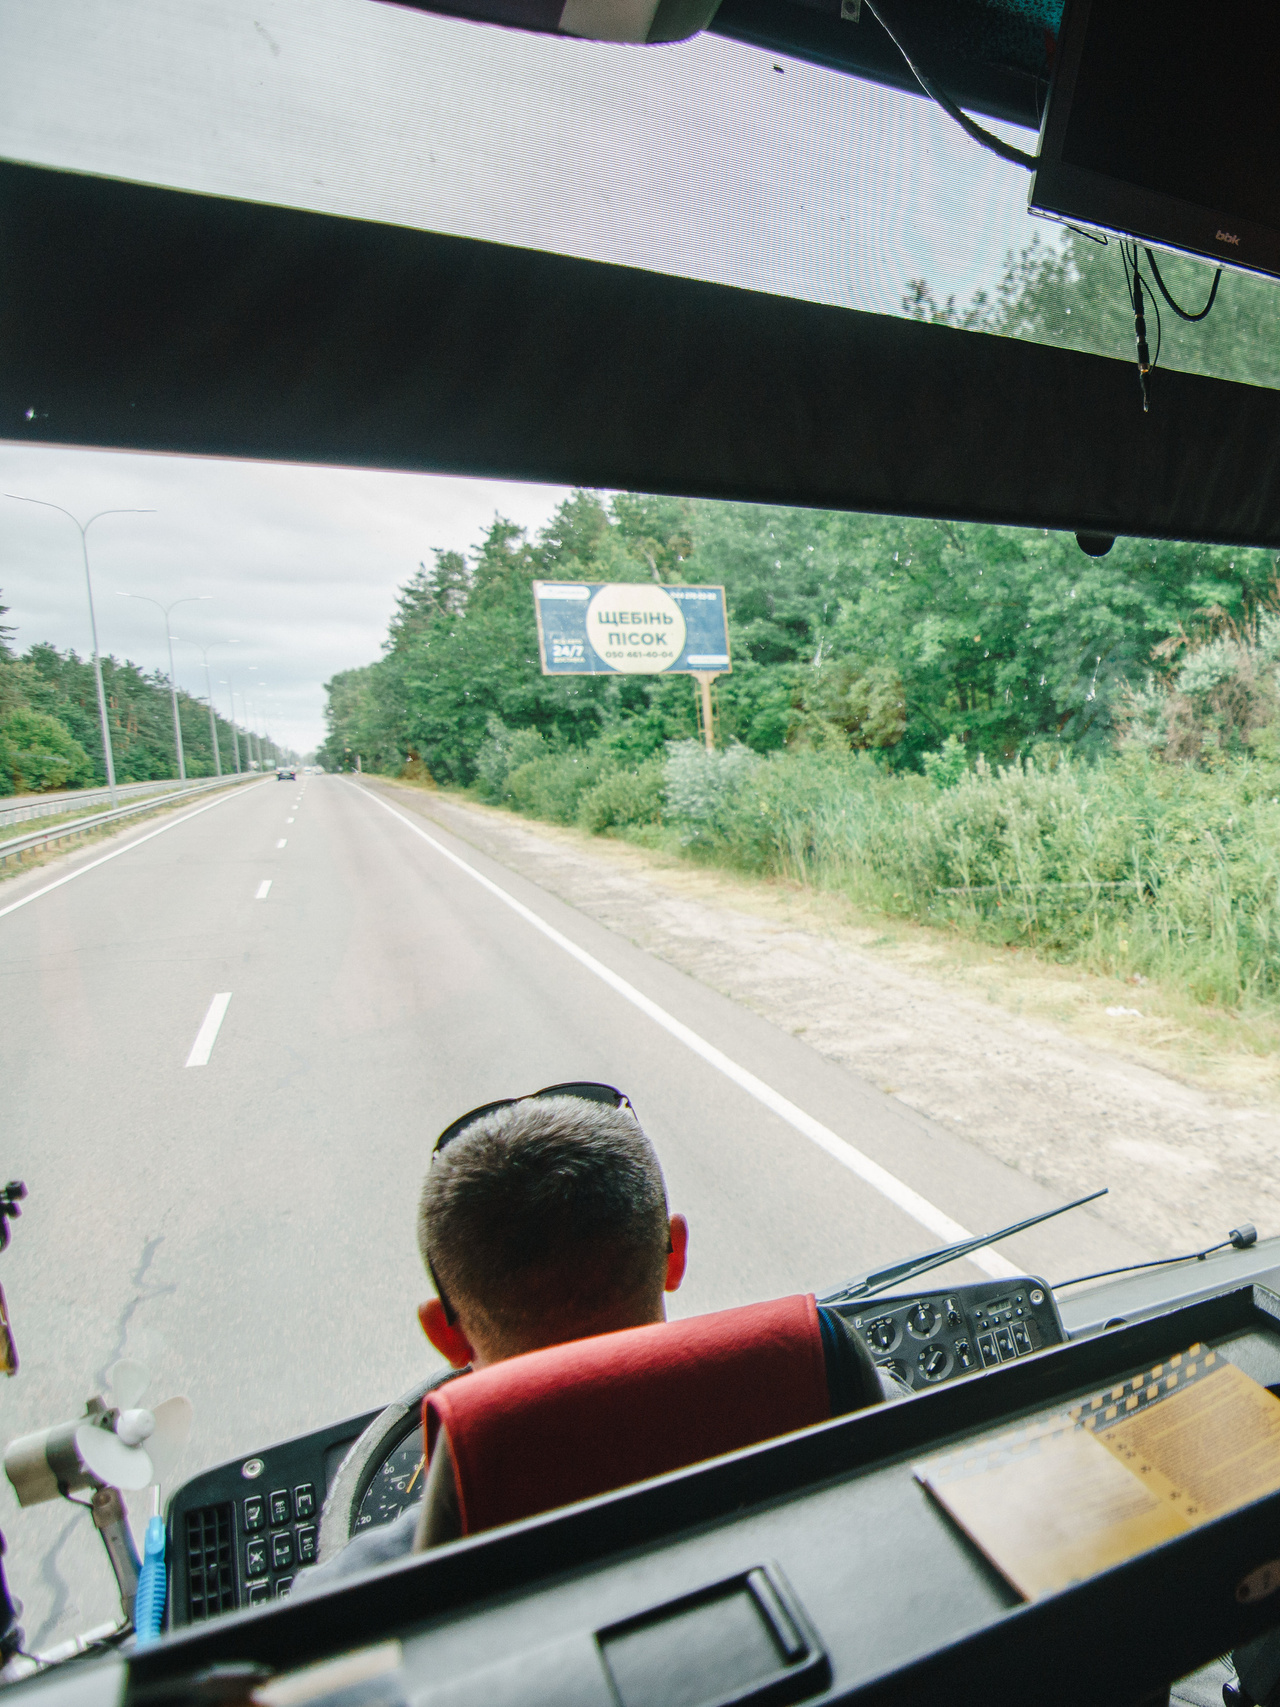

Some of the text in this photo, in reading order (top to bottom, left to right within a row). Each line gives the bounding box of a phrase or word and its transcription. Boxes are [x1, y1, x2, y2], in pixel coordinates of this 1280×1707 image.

[597, 611, 674, 627] ЩЕБІНЬ
[608, 632, 668, 646] ПІСОК
[552, 645, 585, 658] 24/7
[384, 1466, 395, 1475] 60
[361, 1515, 372, 1524] 20
